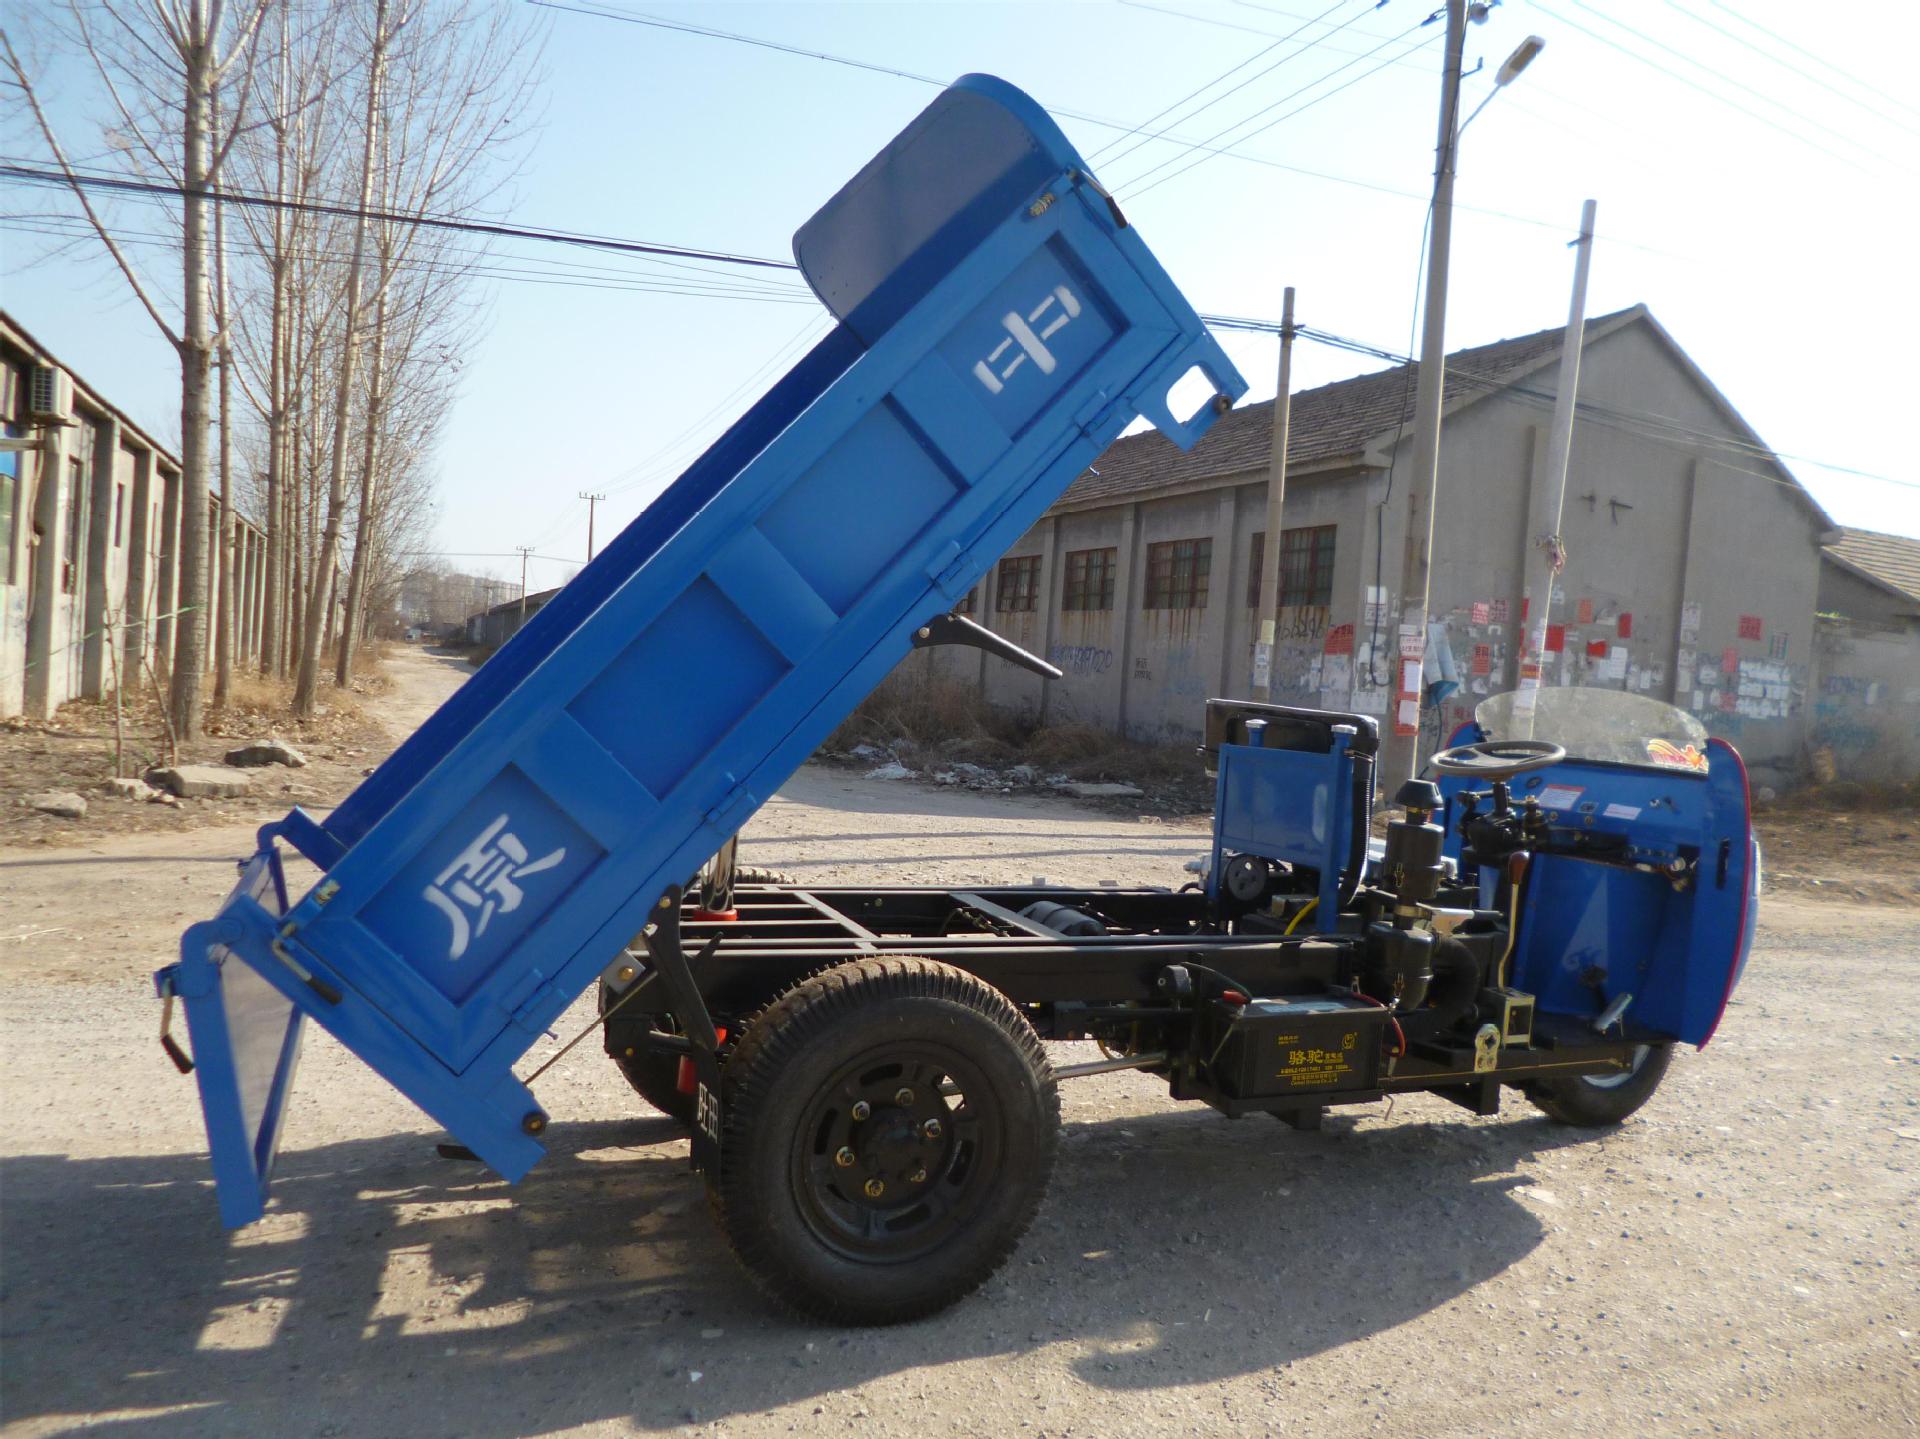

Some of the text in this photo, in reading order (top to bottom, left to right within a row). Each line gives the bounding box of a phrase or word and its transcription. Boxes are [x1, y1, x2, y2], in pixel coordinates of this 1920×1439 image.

[971, 285, 1082, 395] 中
[421, 813, 567, 961] 原
[1288, 1049, 1324, 1065] 骆驼
